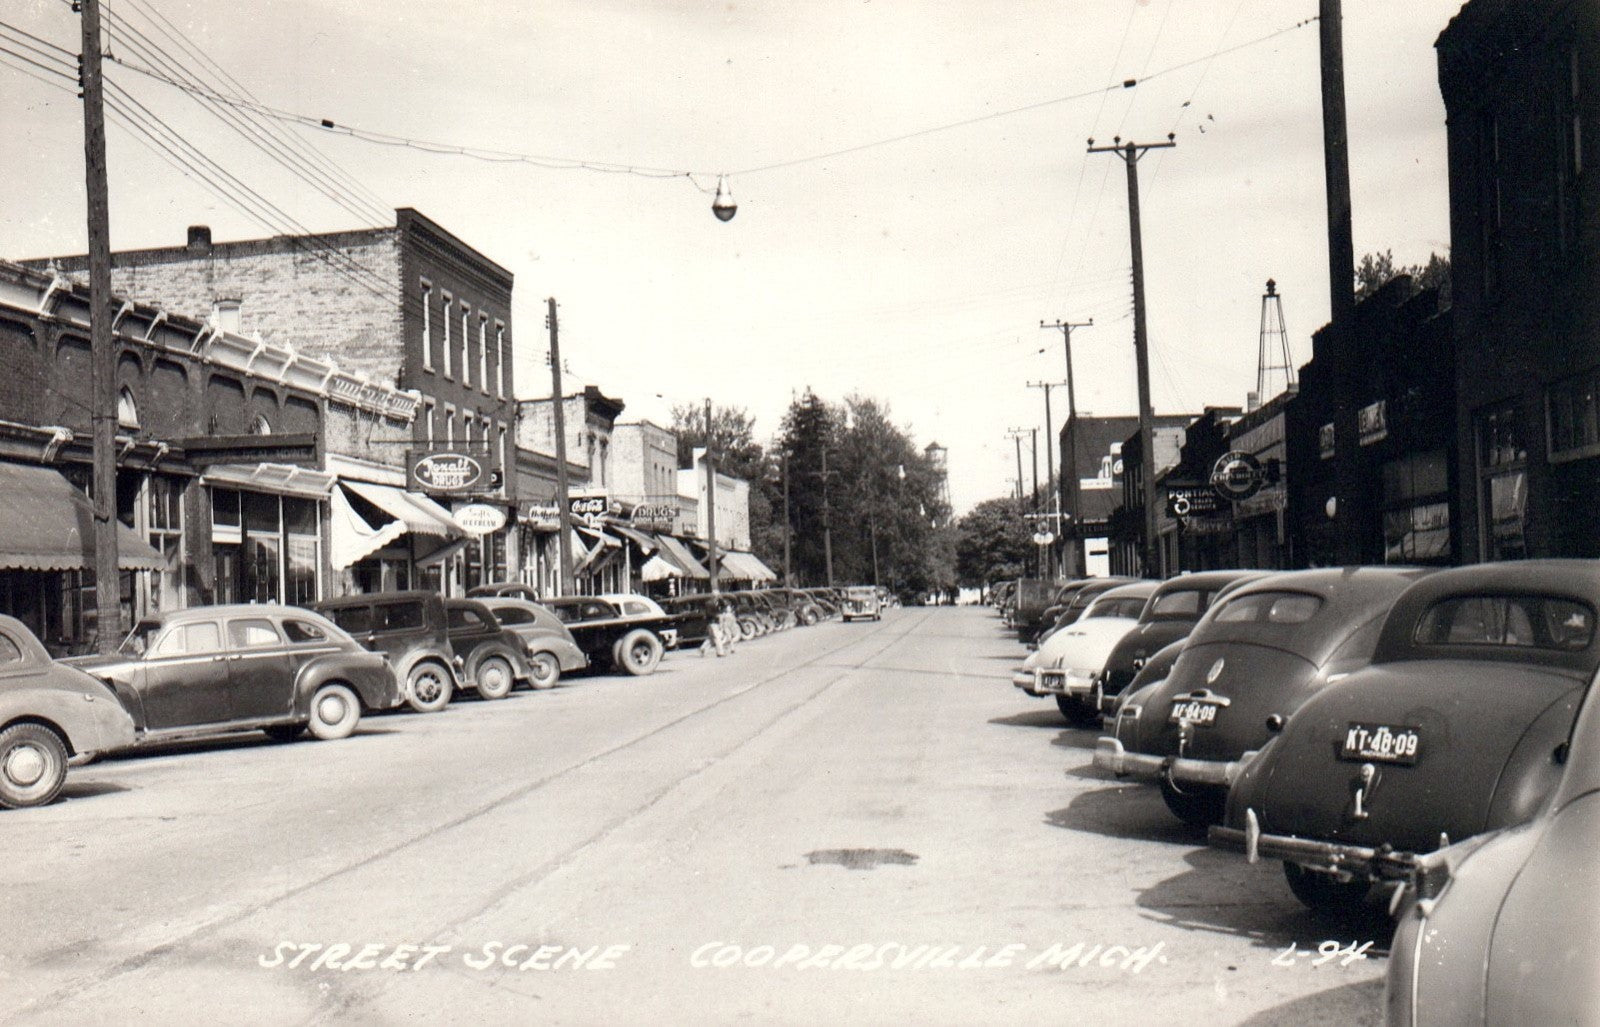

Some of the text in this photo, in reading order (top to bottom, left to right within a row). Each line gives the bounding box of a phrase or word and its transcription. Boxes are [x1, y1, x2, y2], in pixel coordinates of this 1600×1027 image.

[422, 458, 470, 478] Rexall
[1213, 470, 1263, 481] CHEVROLET
[432, 476, 464, 487] DRUGS
[1168, 490, 1215, 500] PONTIAC
[638, 504, 676, 517] DRUGS
